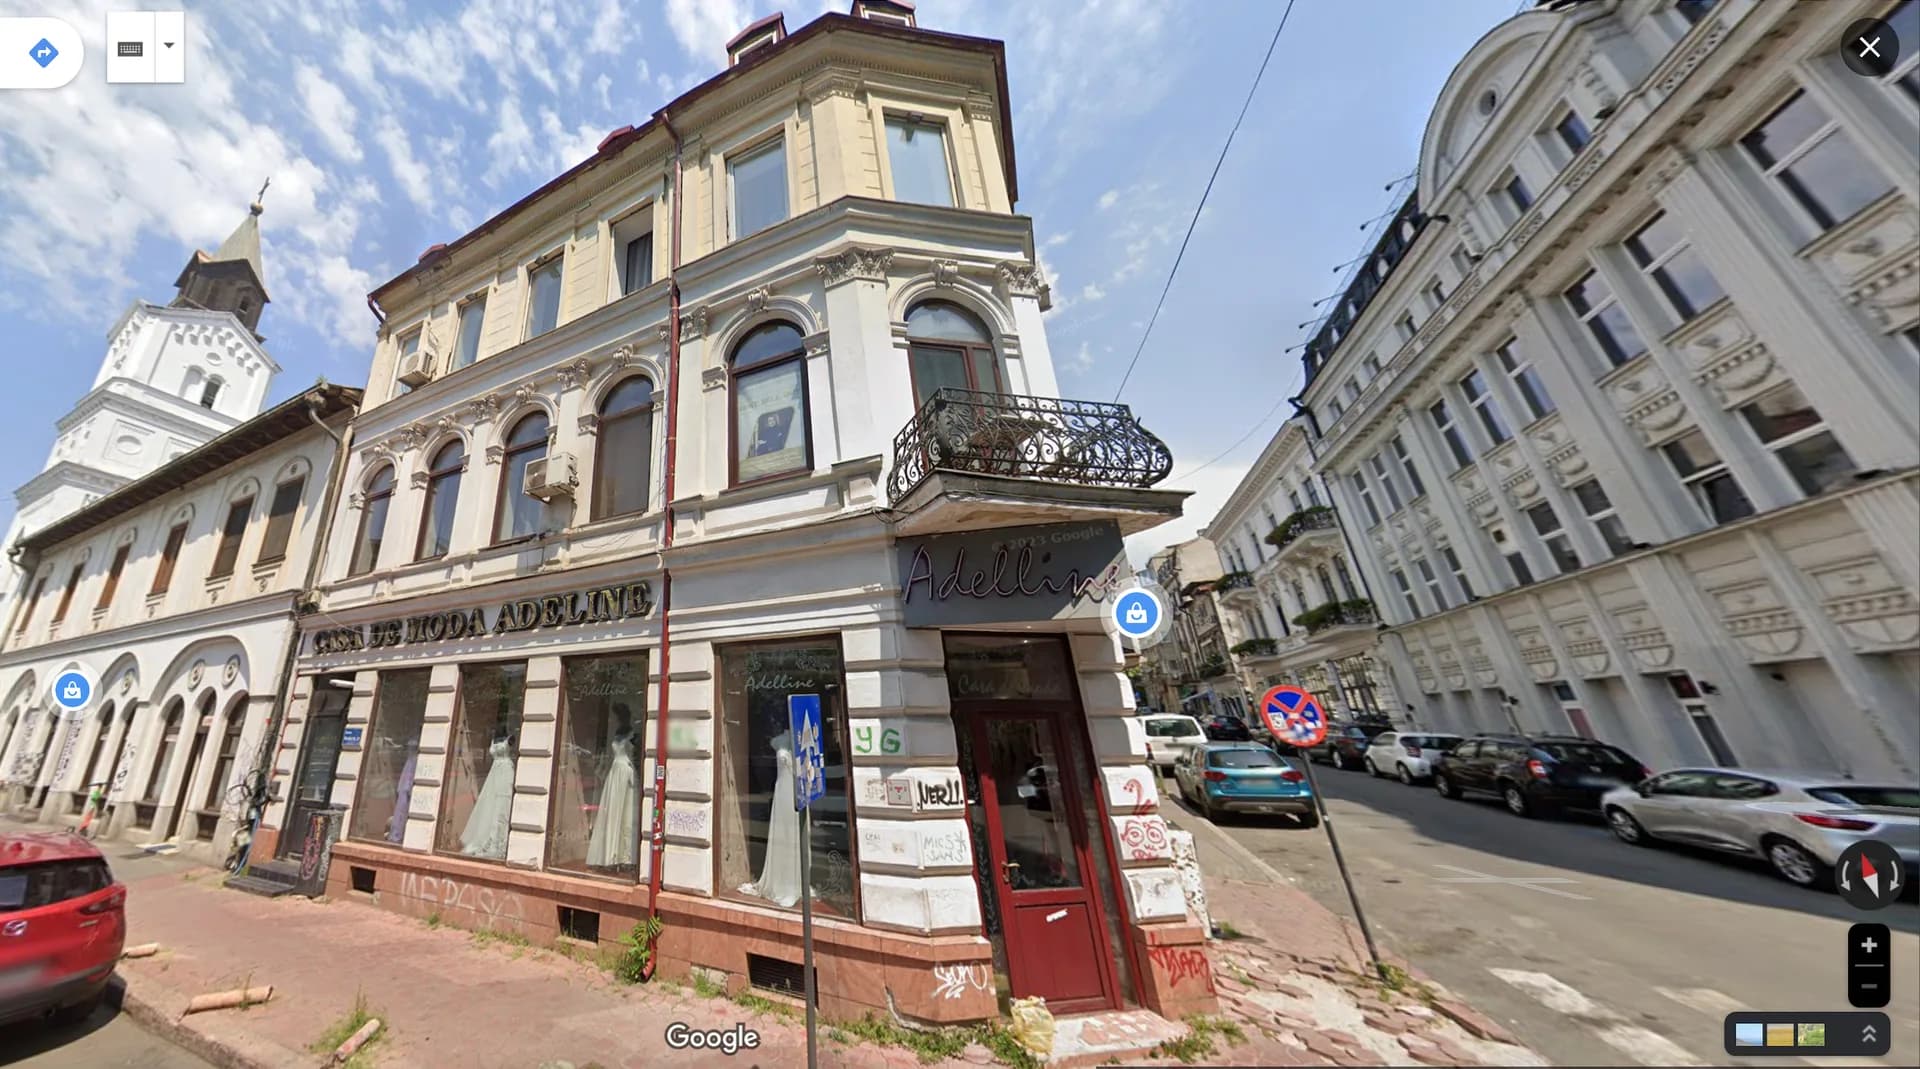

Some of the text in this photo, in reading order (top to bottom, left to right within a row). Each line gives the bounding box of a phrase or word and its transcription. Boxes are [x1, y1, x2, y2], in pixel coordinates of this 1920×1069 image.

[313, 581, 652, 654] CASA DE MODA ADELINE
[744, 673, 816, 692] Adelline
